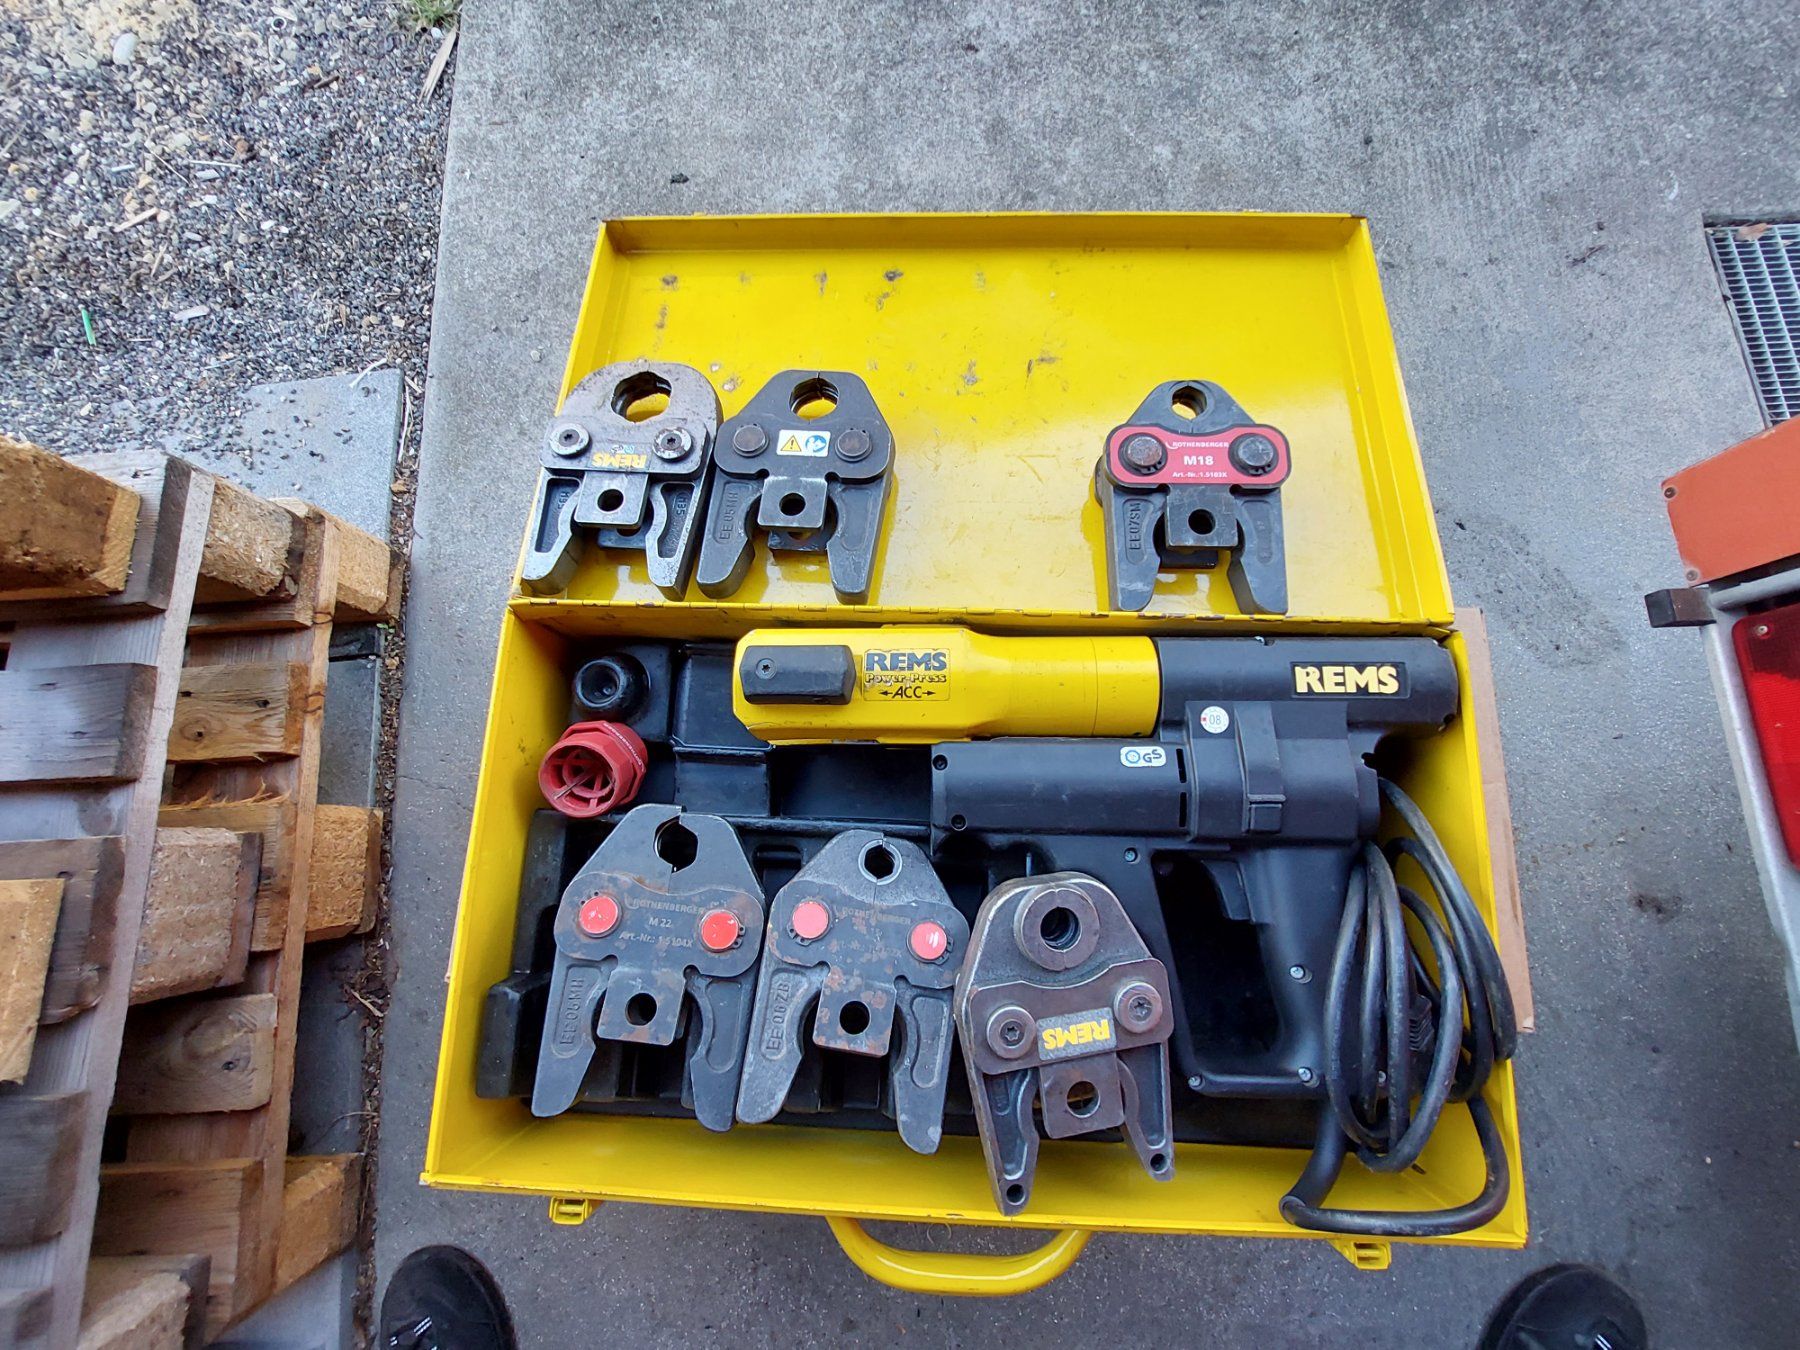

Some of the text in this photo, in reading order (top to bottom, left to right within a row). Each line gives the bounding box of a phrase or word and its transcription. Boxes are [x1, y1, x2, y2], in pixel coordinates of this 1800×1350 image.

[592, 452, 648, 469] REMS
[1183, 455, 1214, 466] M18
[865, 652, 947, 672] REMS
[865, 673, 947, 683] Power-Press
[1294, 666, 1399, 694] REMS
[892, 686, 922, 698] ACC
[1143, 749, 1162, 763] GS
[1042, 1019, 1111, 1050] REMS
